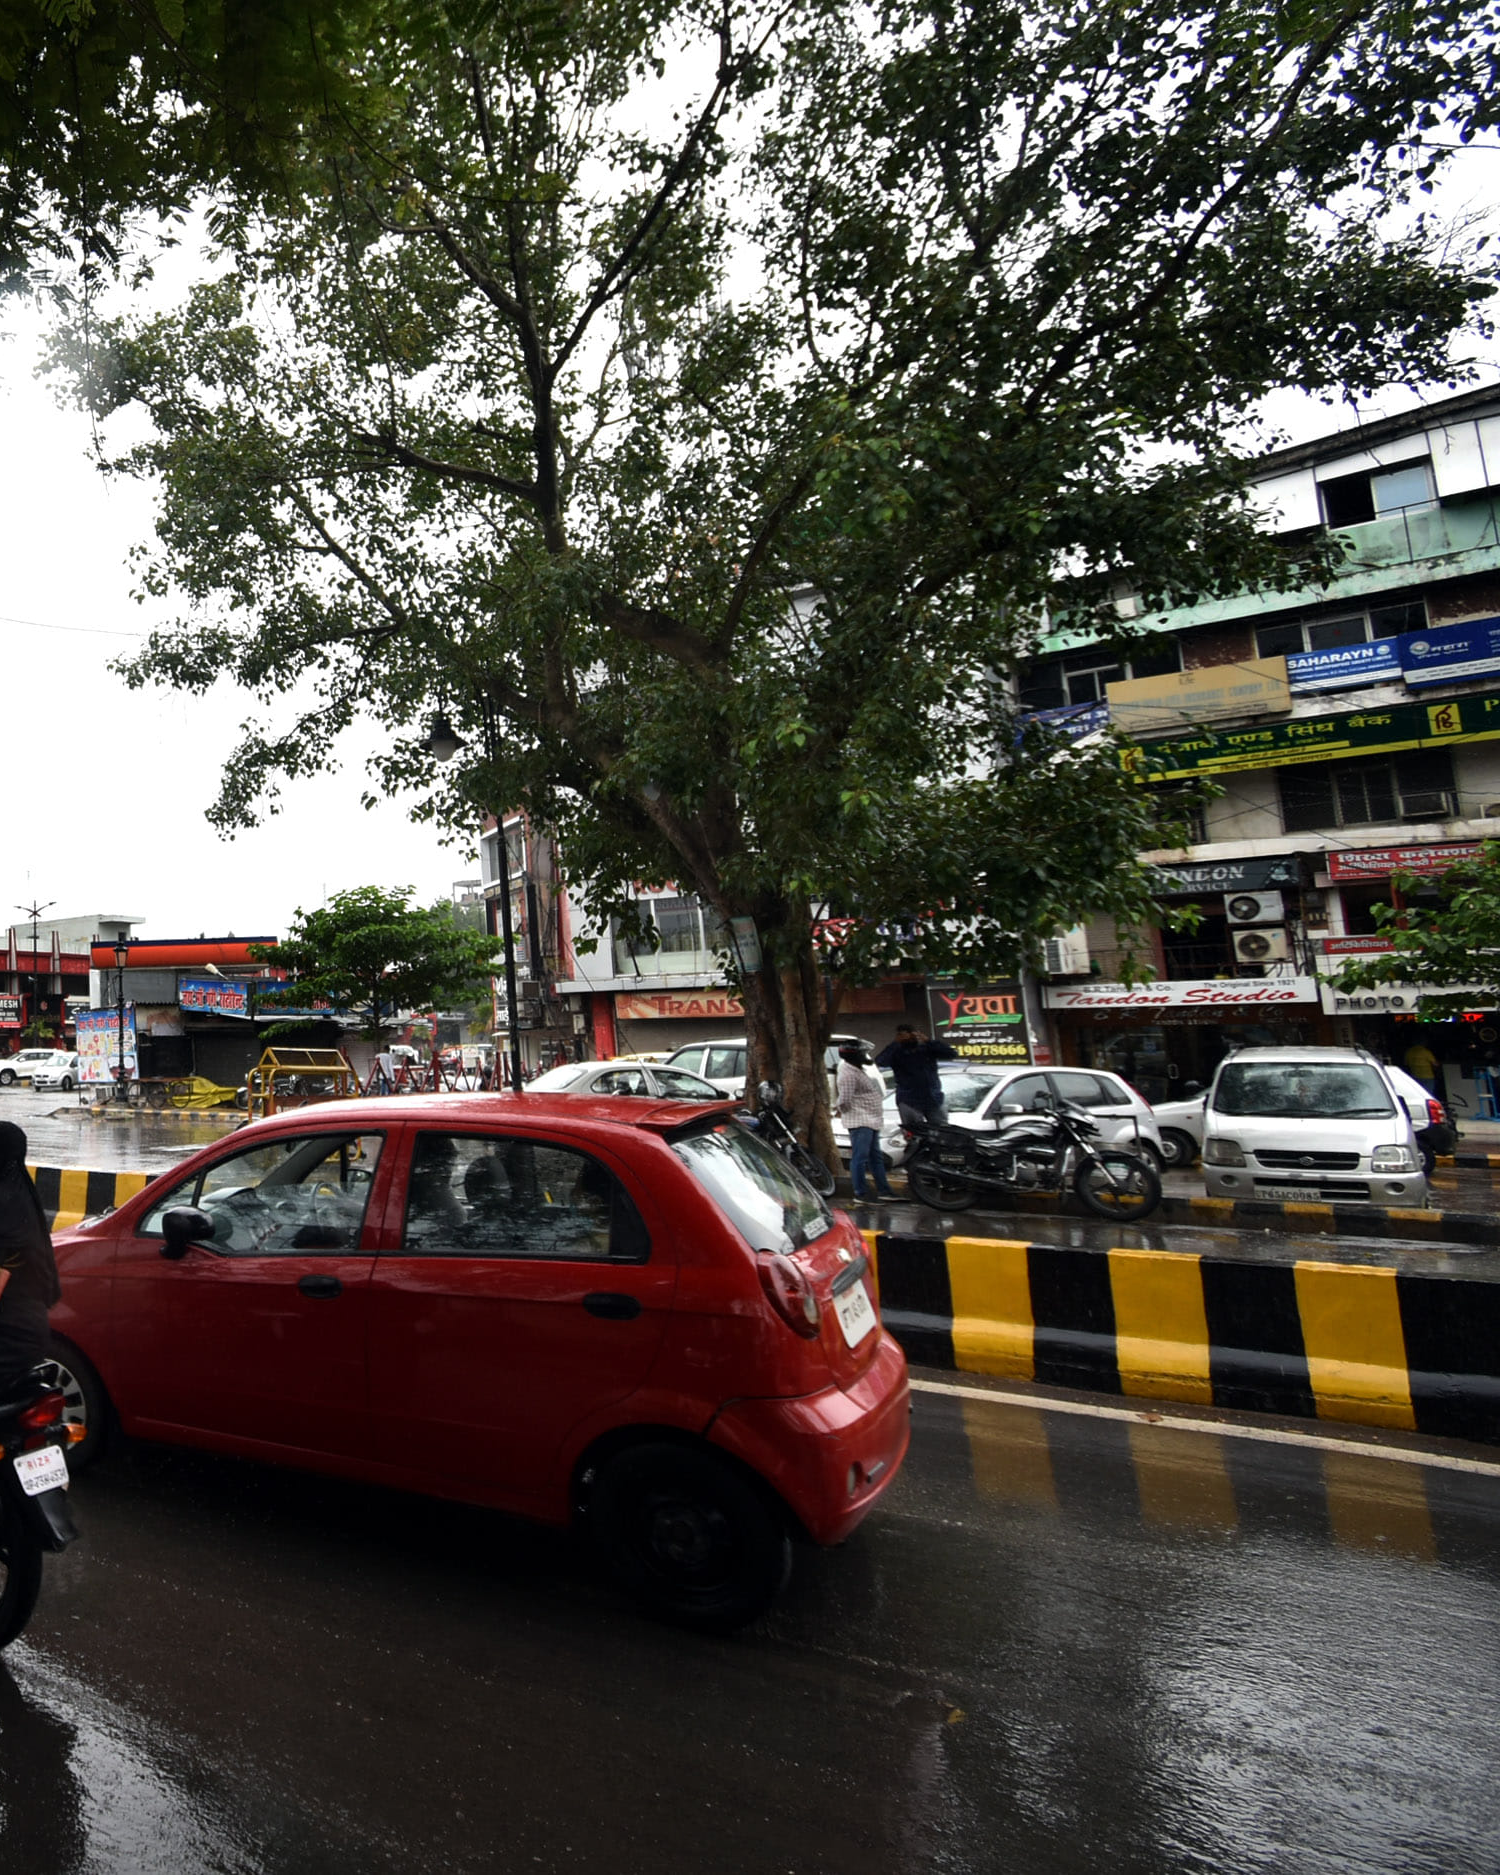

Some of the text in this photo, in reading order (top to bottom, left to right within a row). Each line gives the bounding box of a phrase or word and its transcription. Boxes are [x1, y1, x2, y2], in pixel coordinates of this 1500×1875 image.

[1287, 648, 1373, 669] SAHARAYN
[1220, 981, 1250, 989] Original
[652, 996, 742, 1016] TRANS
[1056, 988, 1299, 1006] Tandon Studio
[1336, 996, 1404, 1010] PHOTO
[962, 995, 1017, 1023] युवा
